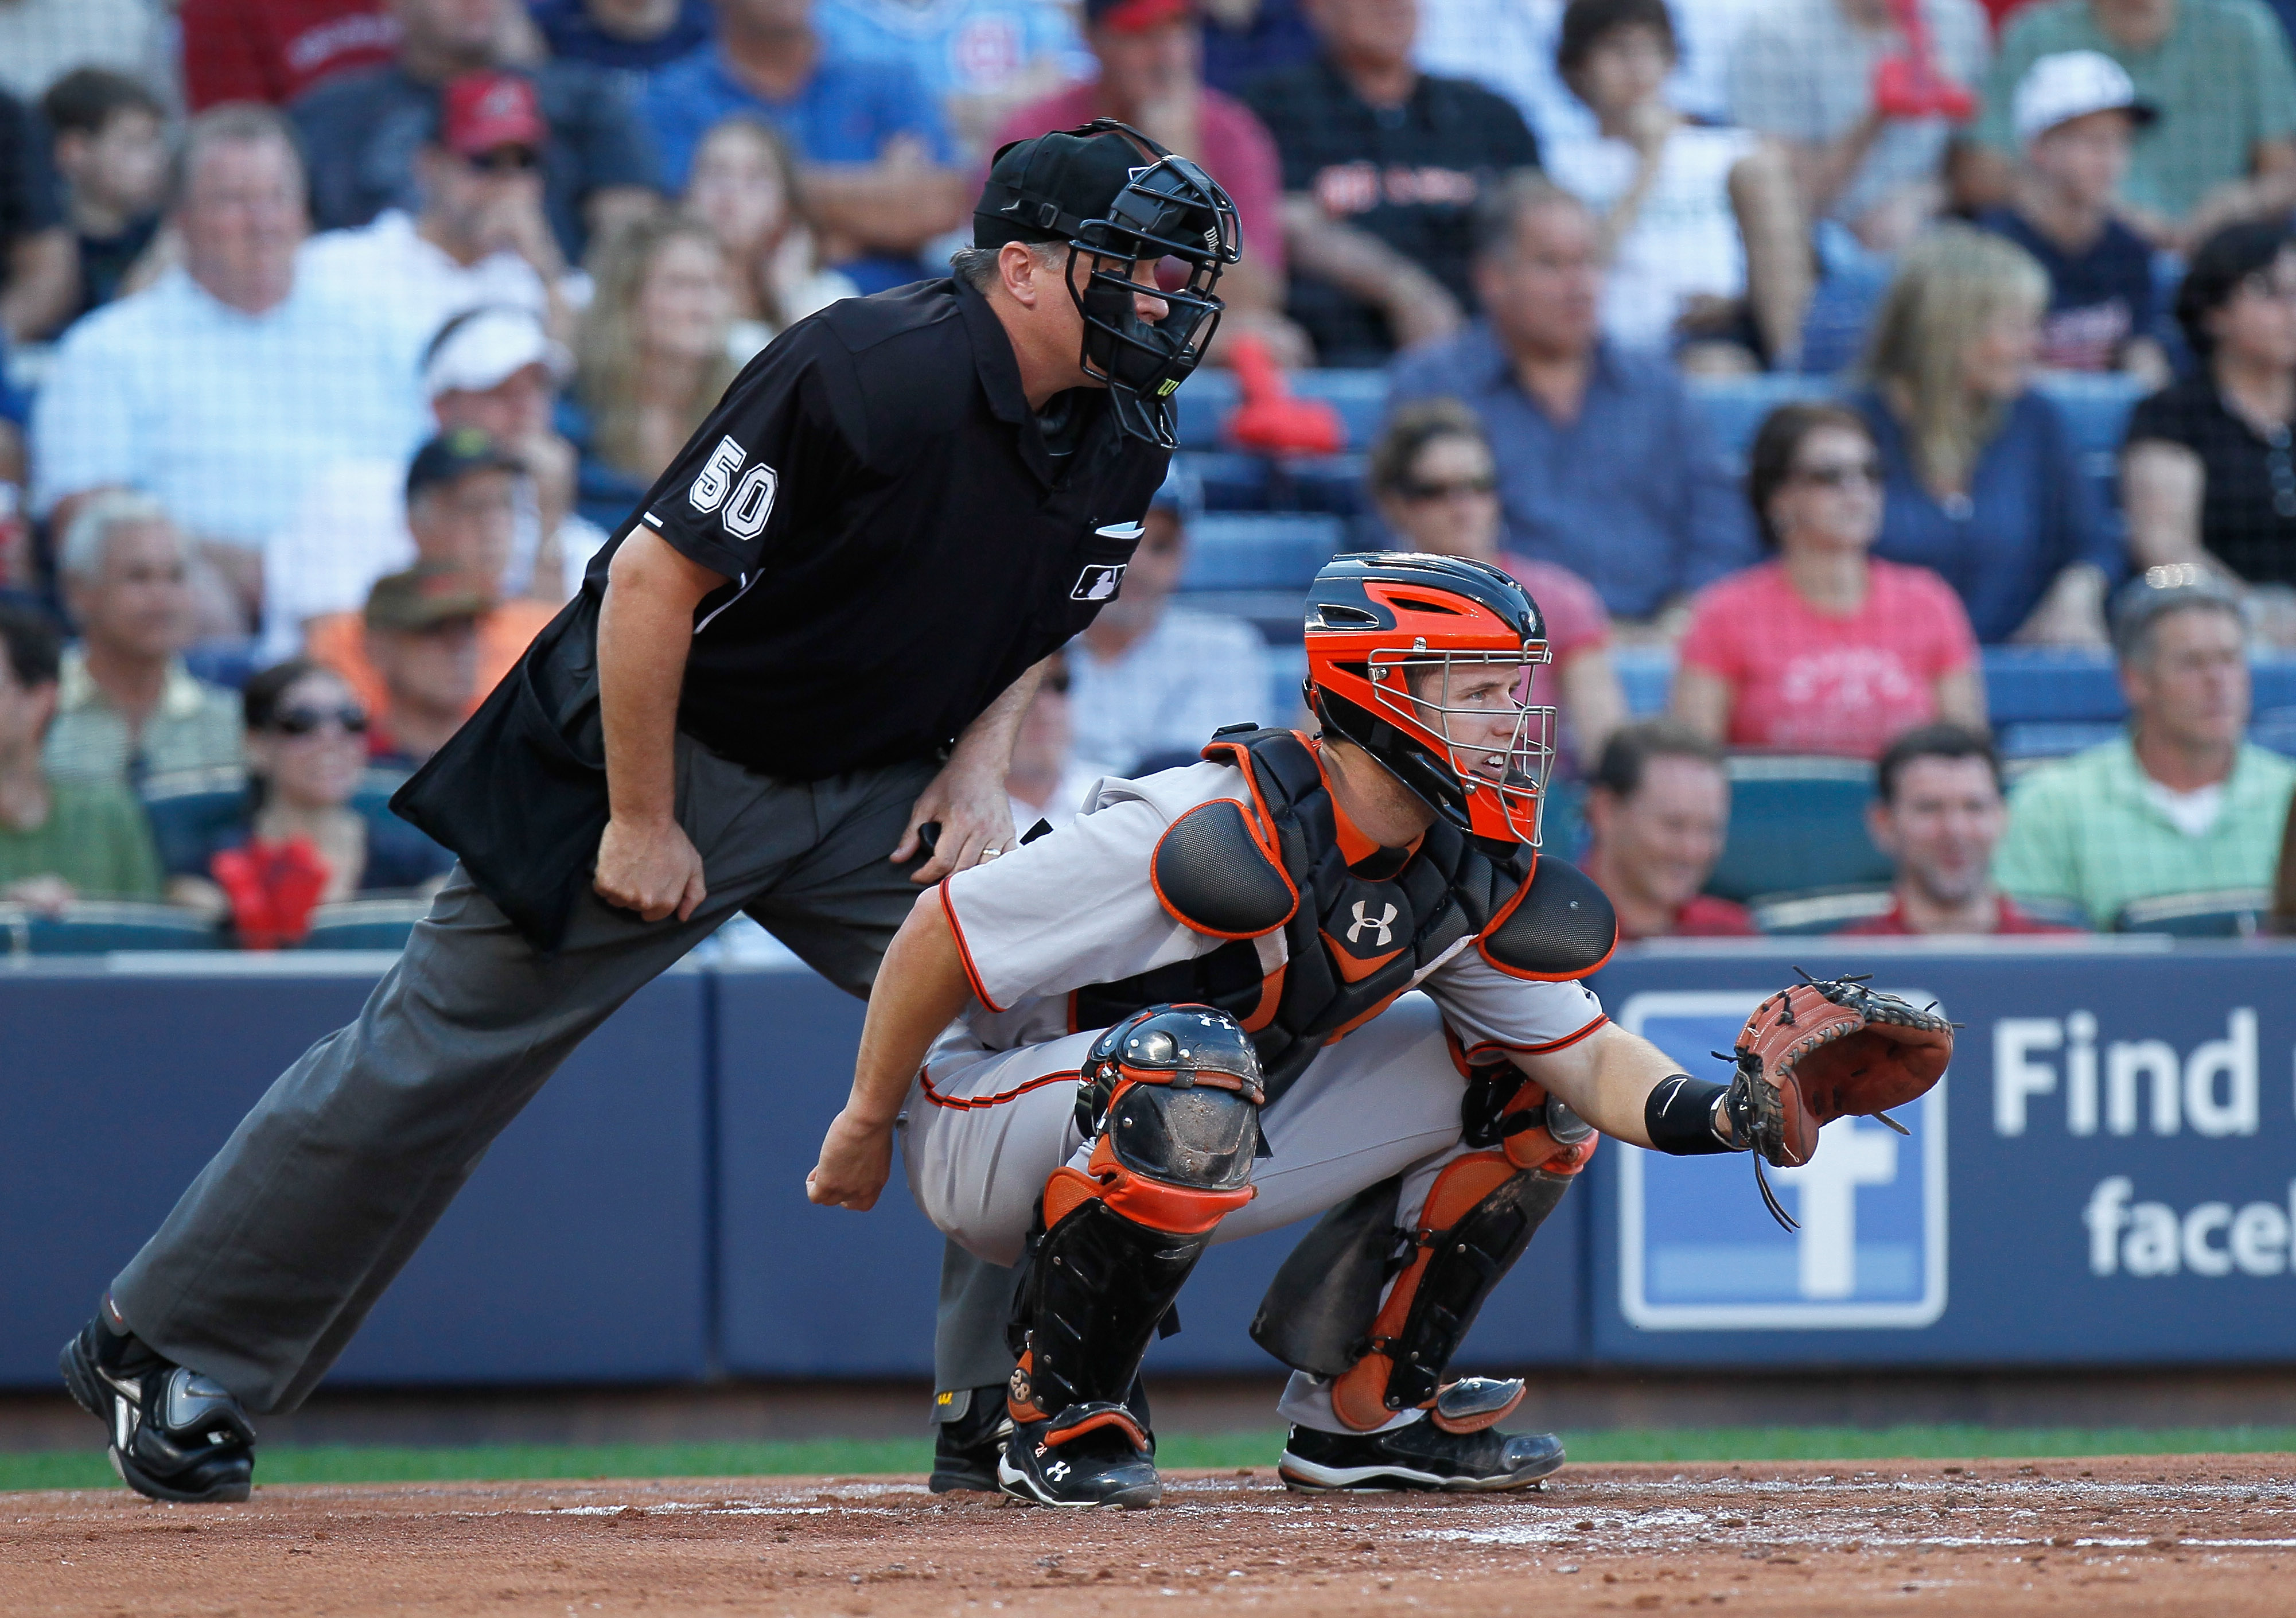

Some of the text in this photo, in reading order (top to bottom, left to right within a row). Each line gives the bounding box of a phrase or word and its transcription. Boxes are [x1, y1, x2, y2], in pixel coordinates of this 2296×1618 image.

[690, 435, 778, 540] 50
[1993, 1007, 2259, 1137] Find
[2084, 1176, 2296, 1276] face
[1010, 1369, 1030, 1402] 28
[1035, 1442, 1048, 1457] 28
